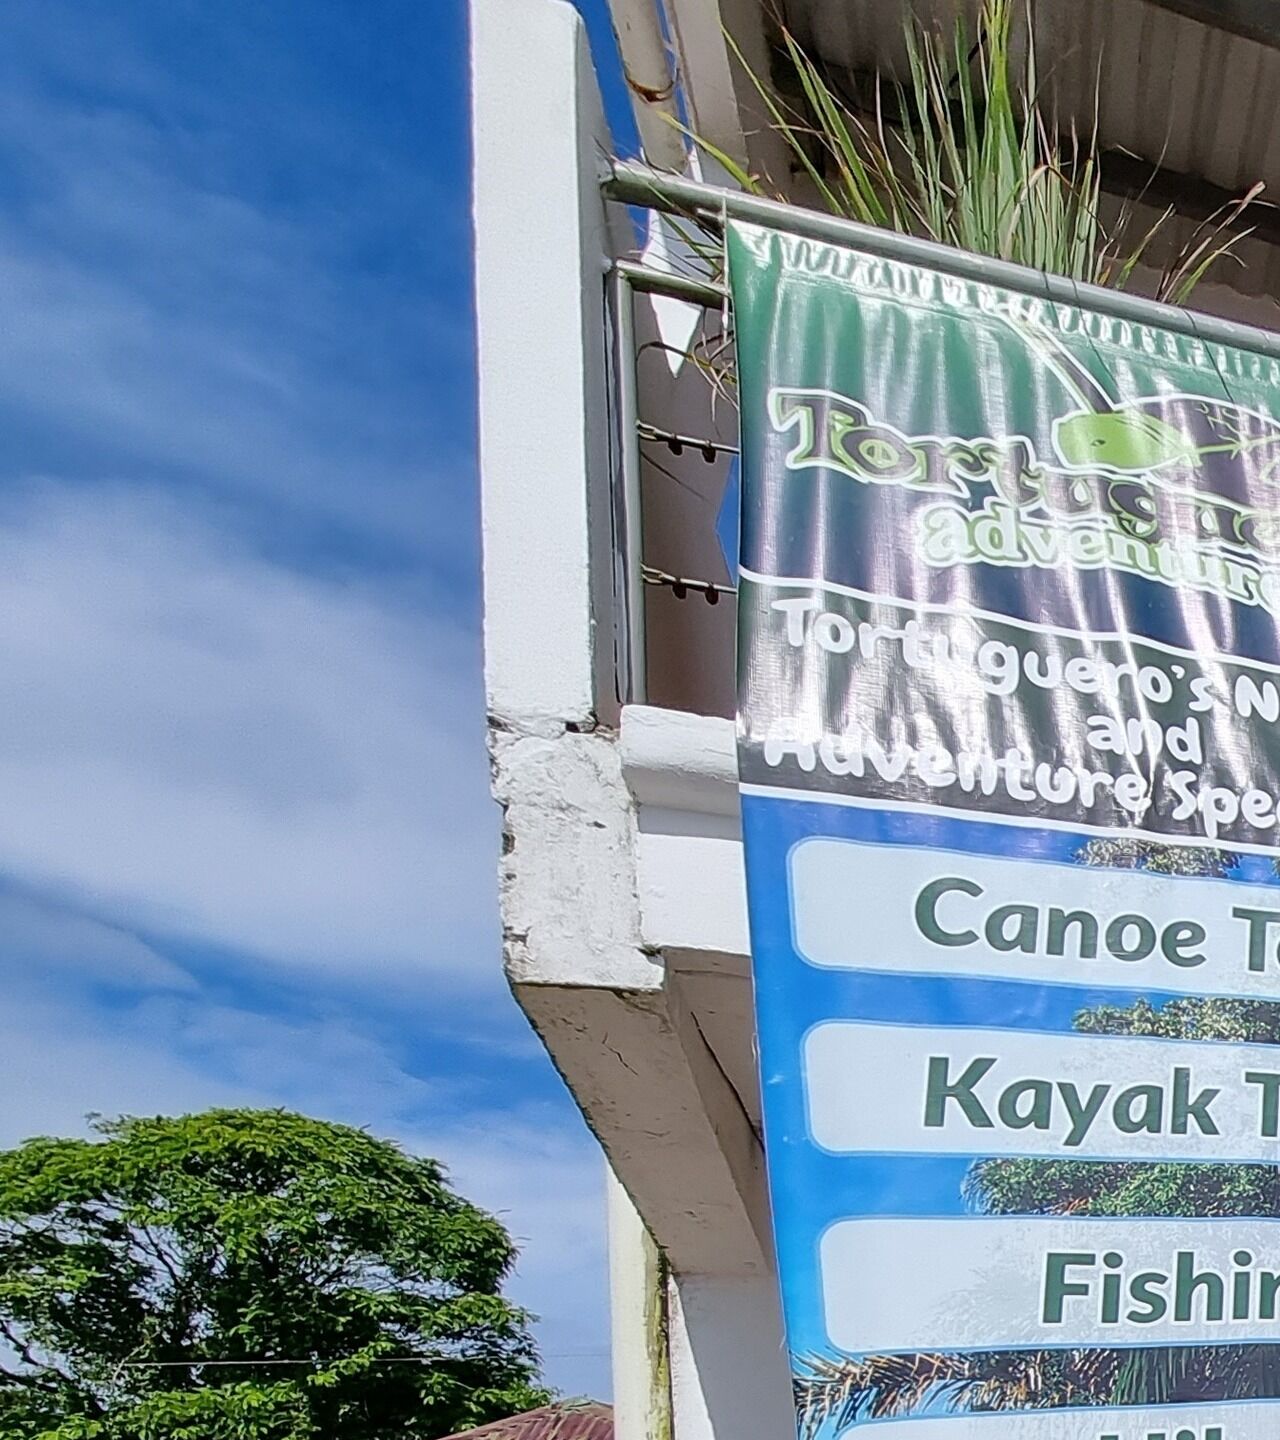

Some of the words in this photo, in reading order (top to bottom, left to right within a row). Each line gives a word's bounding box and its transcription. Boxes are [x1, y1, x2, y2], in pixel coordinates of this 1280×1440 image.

[764, 718, 1152, 814] Adventure
[1087, 714, 1203, 766] and
[914, 877, 1207, 968] Canoe
[923, 1056, 1222, 1147] Kayak
